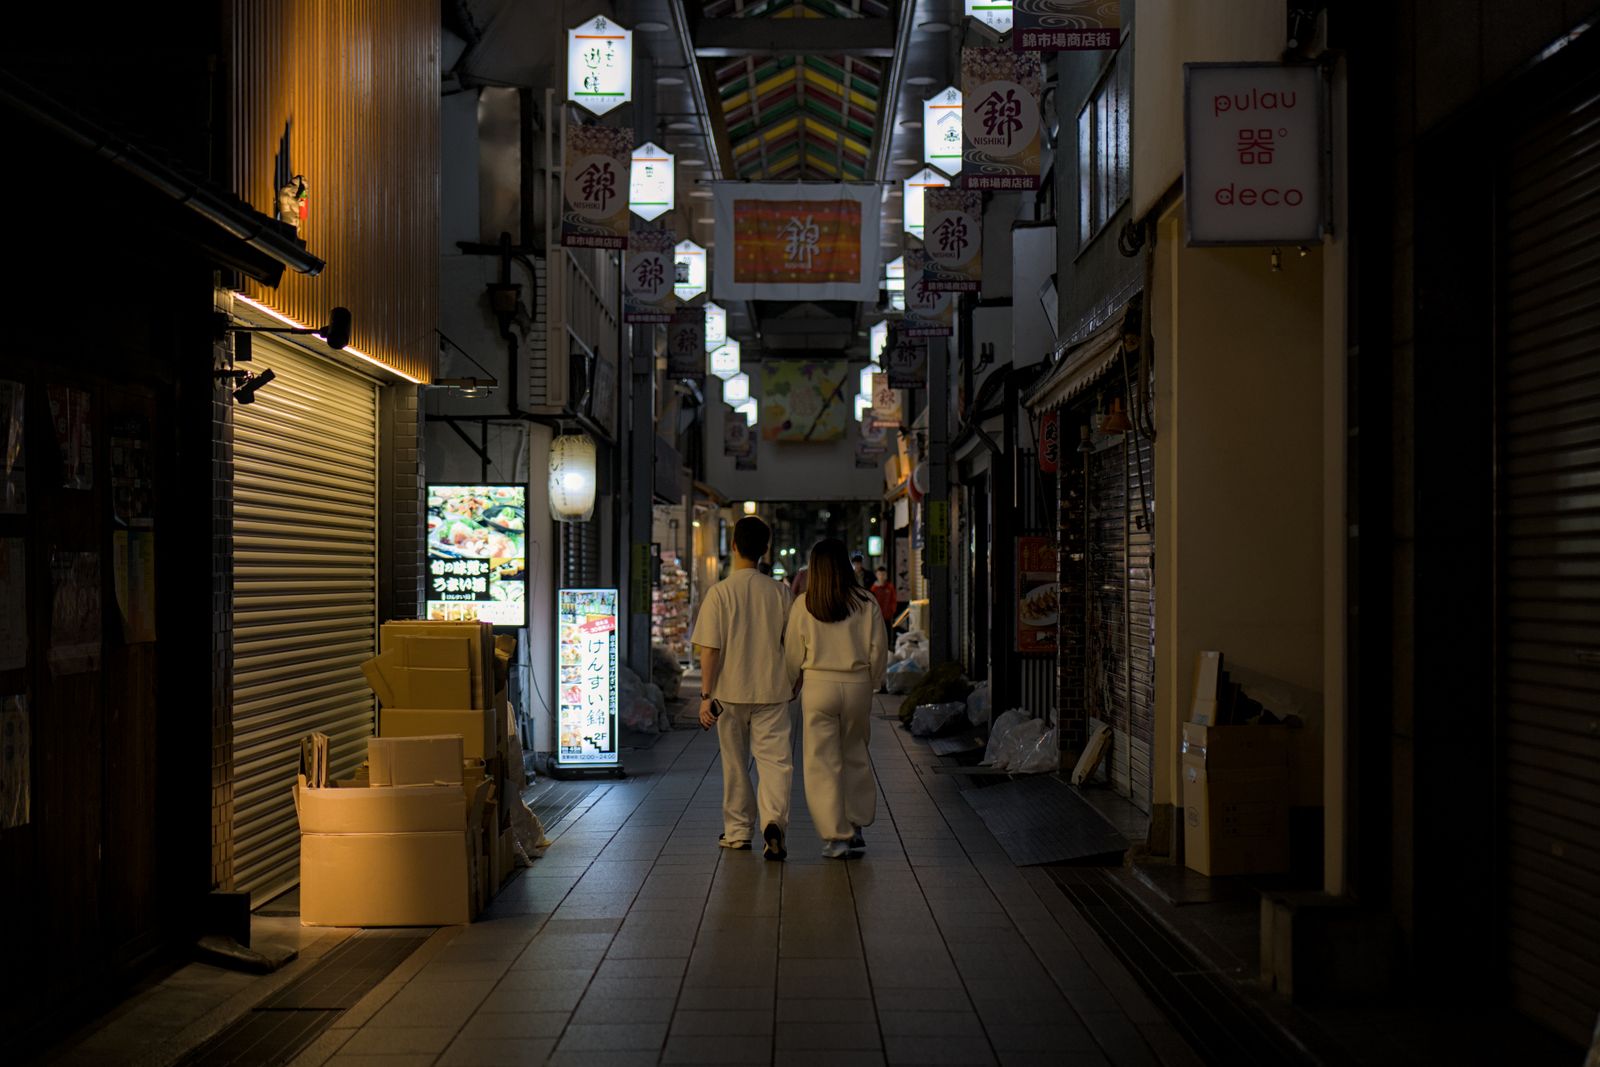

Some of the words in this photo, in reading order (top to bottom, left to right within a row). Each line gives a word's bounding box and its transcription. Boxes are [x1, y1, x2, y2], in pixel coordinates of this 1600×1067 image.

[1021, 31, 1111, 48] 錦市場商店街
[1215, 88, 1296, 117] pulau
[974, 89, 1023, 148] 錦
[973, 137, 1005, 146] NISHIKI
[575, 162, 616, 212] 錦
[968, 177, 1034, 189] 錦市場商店街
[1215, 183, 1303, 206] deco
[776, 214, 820, 270] 錦
[932, 216, 968, 260] 錦
[632, 257, 664, 295] 錦
[594, 732, 607, 741] 2F
